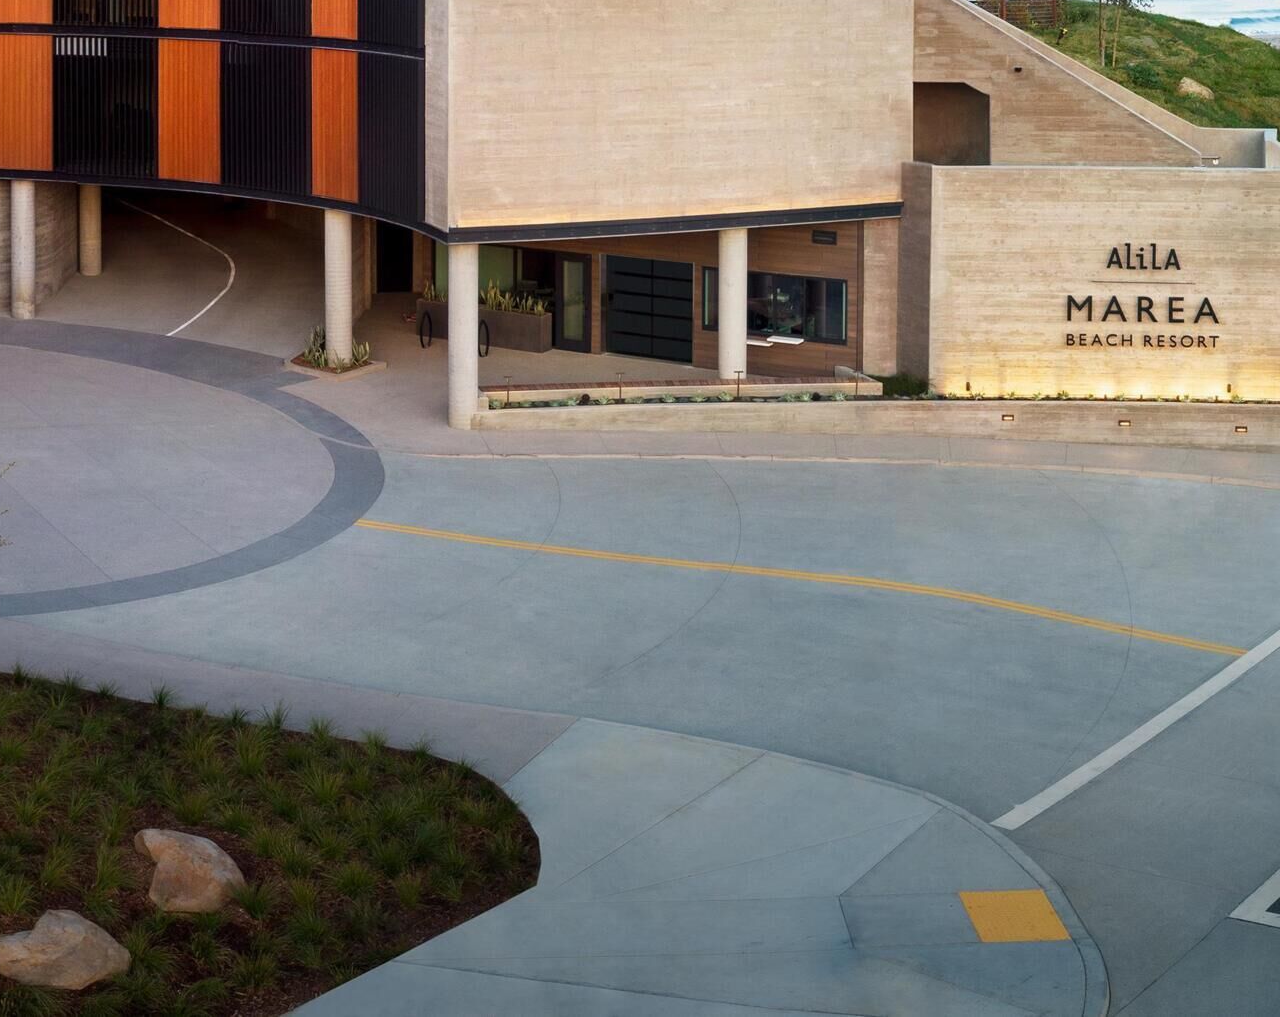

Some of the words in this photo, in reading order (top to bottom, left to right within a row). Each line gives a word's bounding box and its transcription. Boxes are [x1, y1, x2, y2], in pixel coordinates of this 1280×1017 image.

[1066, 294, 1220, 324] MAREA
[1065, 333, 1133, 347] BEACH
[1143, 334, 1220, 348] RESORT
